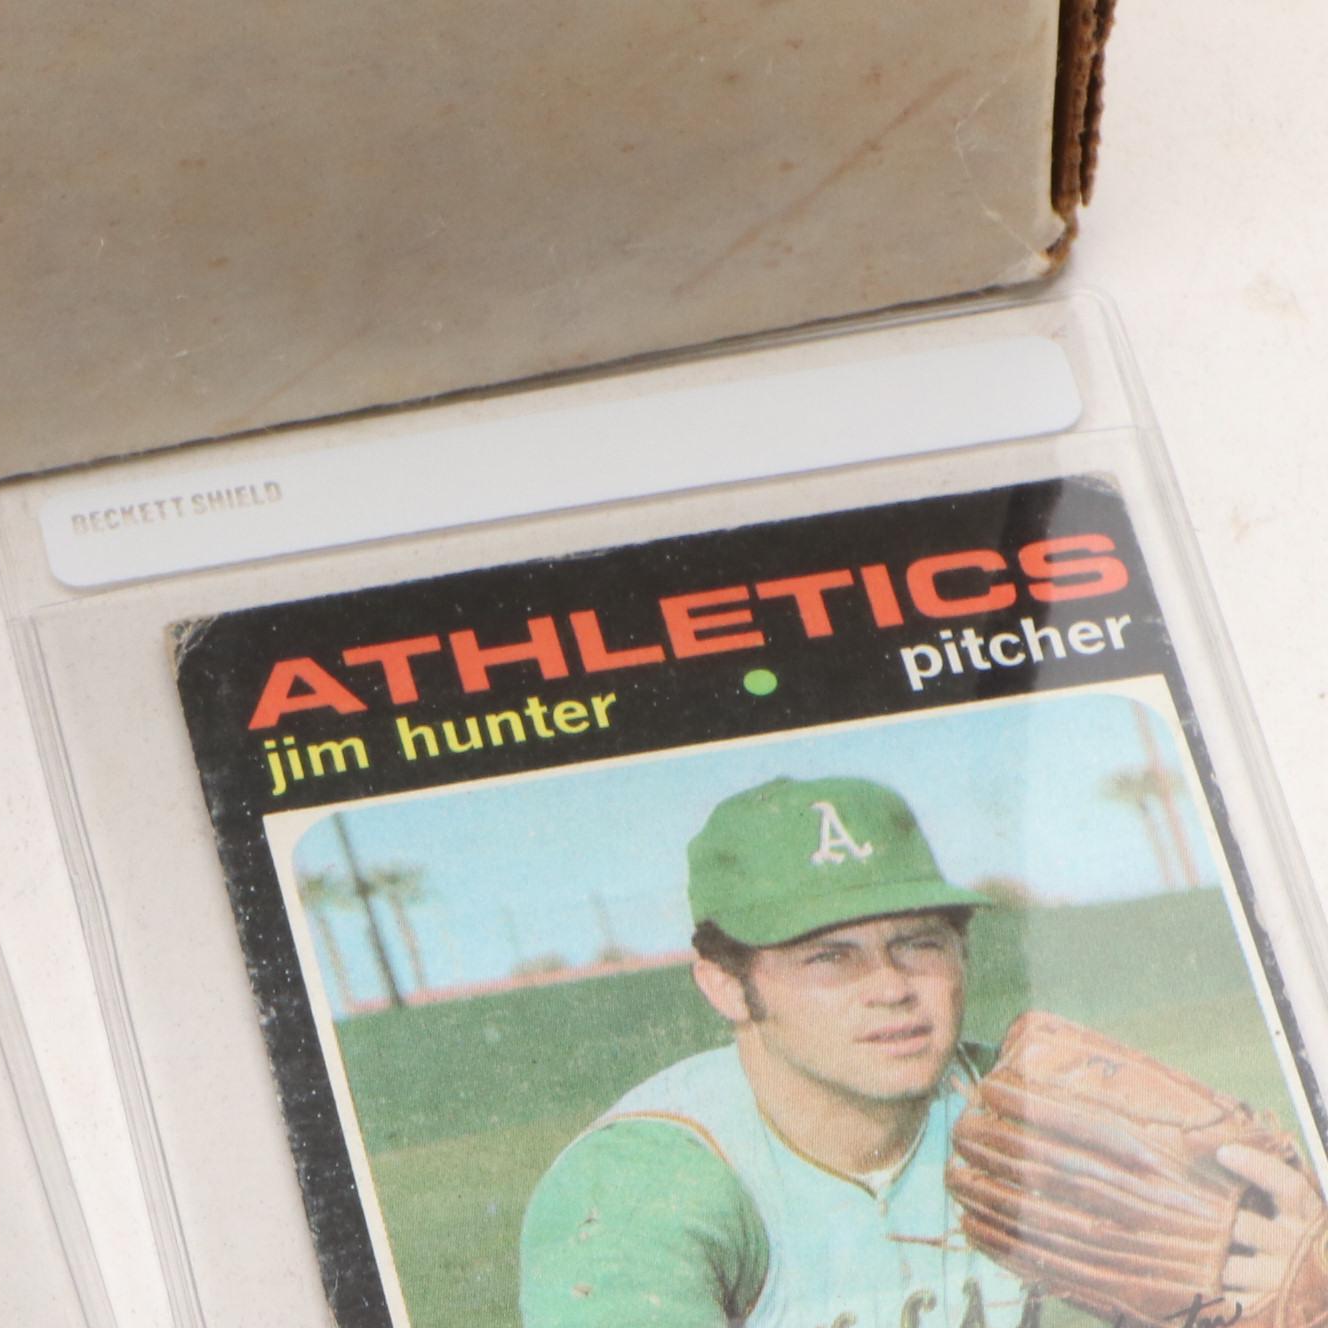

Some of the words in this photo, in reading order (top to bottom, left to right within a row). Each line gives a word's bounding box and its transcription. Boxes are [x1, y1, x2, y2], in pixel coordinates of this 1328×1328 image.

[71, 497, 184, 536] BECKETT
[191, 481, 284, 515] SHIELD
[248, 533, 1129, 730] ATHLETICS
[900, 614, 1131, 691] pitcher
[264, 734, 368, 795] jim
[396, 690, 617, 761] hunter
[810, 801, 872, 865] A
